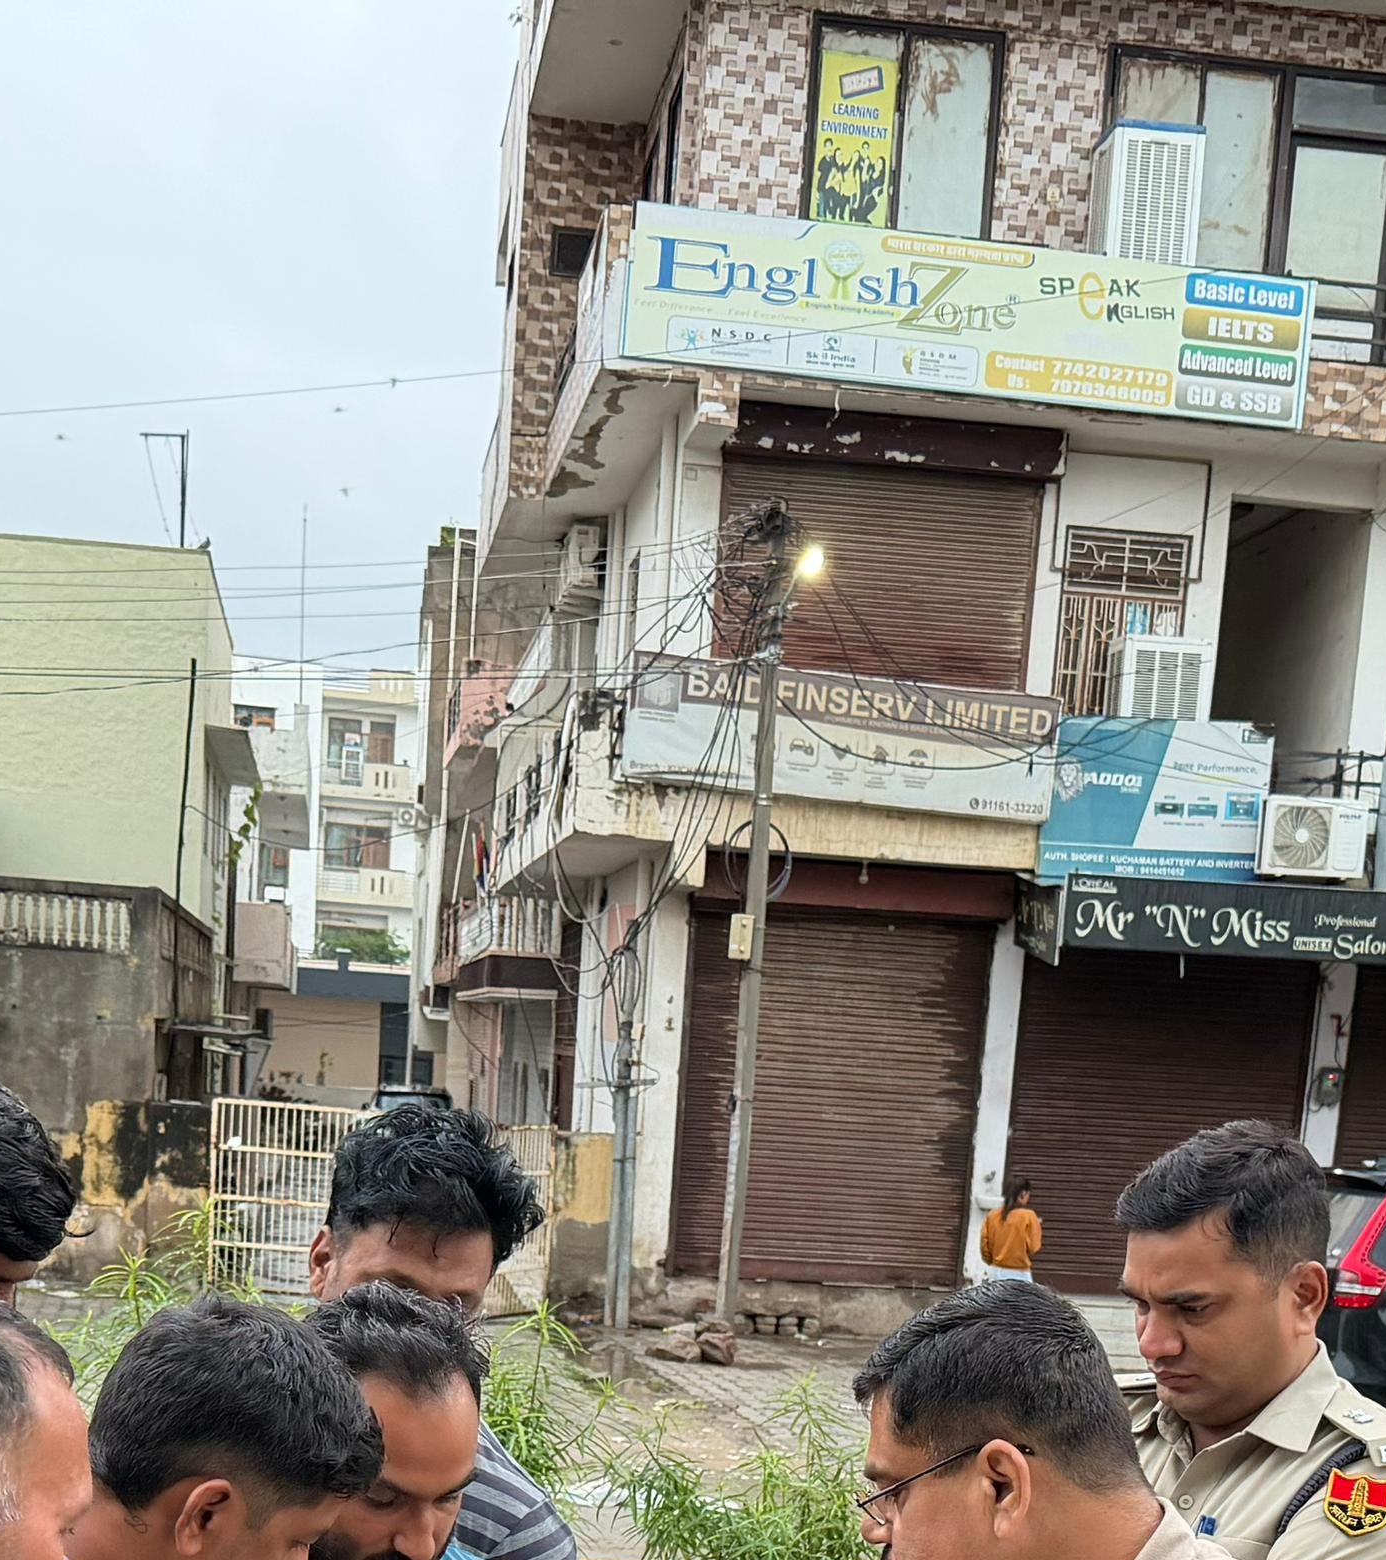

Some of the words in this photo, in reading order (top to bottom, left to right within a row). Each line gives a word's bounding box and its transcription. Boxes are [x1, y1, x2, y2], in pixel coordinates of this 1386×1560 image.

[832, 102, 880, 120] LEARNING
[820, 119, 889, 140] ENVIRONMENT
[896, 261, 1017, 335] Zone
[1193, 278, 1245, 304] Basic
[1248, 283, 1295, 311] Level
[1207, 316, 1275, 344] IELTS
[995, 354, 1045, 373] Contact
[1181, 349, 1252, 377] Advanced
[1253, 358, 1294, 383] Level
[1186, 384, 1218, 408] GD
[1220, 390, 1236, 410] &
[1239, 390, 1282, 416] SSB
[776, 681, 917, 721] FINSERV
[924, 699, 1053, 737] LIMITED
[1070, 853, 1104, 864] SHOPEE
[1110, 855, 1158, 866] KUCHAMAN
[1159, 858, 1196, 869] BATTERY
[1196, 859, 1215, 869] AND
[1074, 899, 1134, 940] Mr
[1211, 908, 1291, 949] Miss
[1314, 913, 1378, 931] Professional
[1293, 937, 1332, 952] UNISEX
